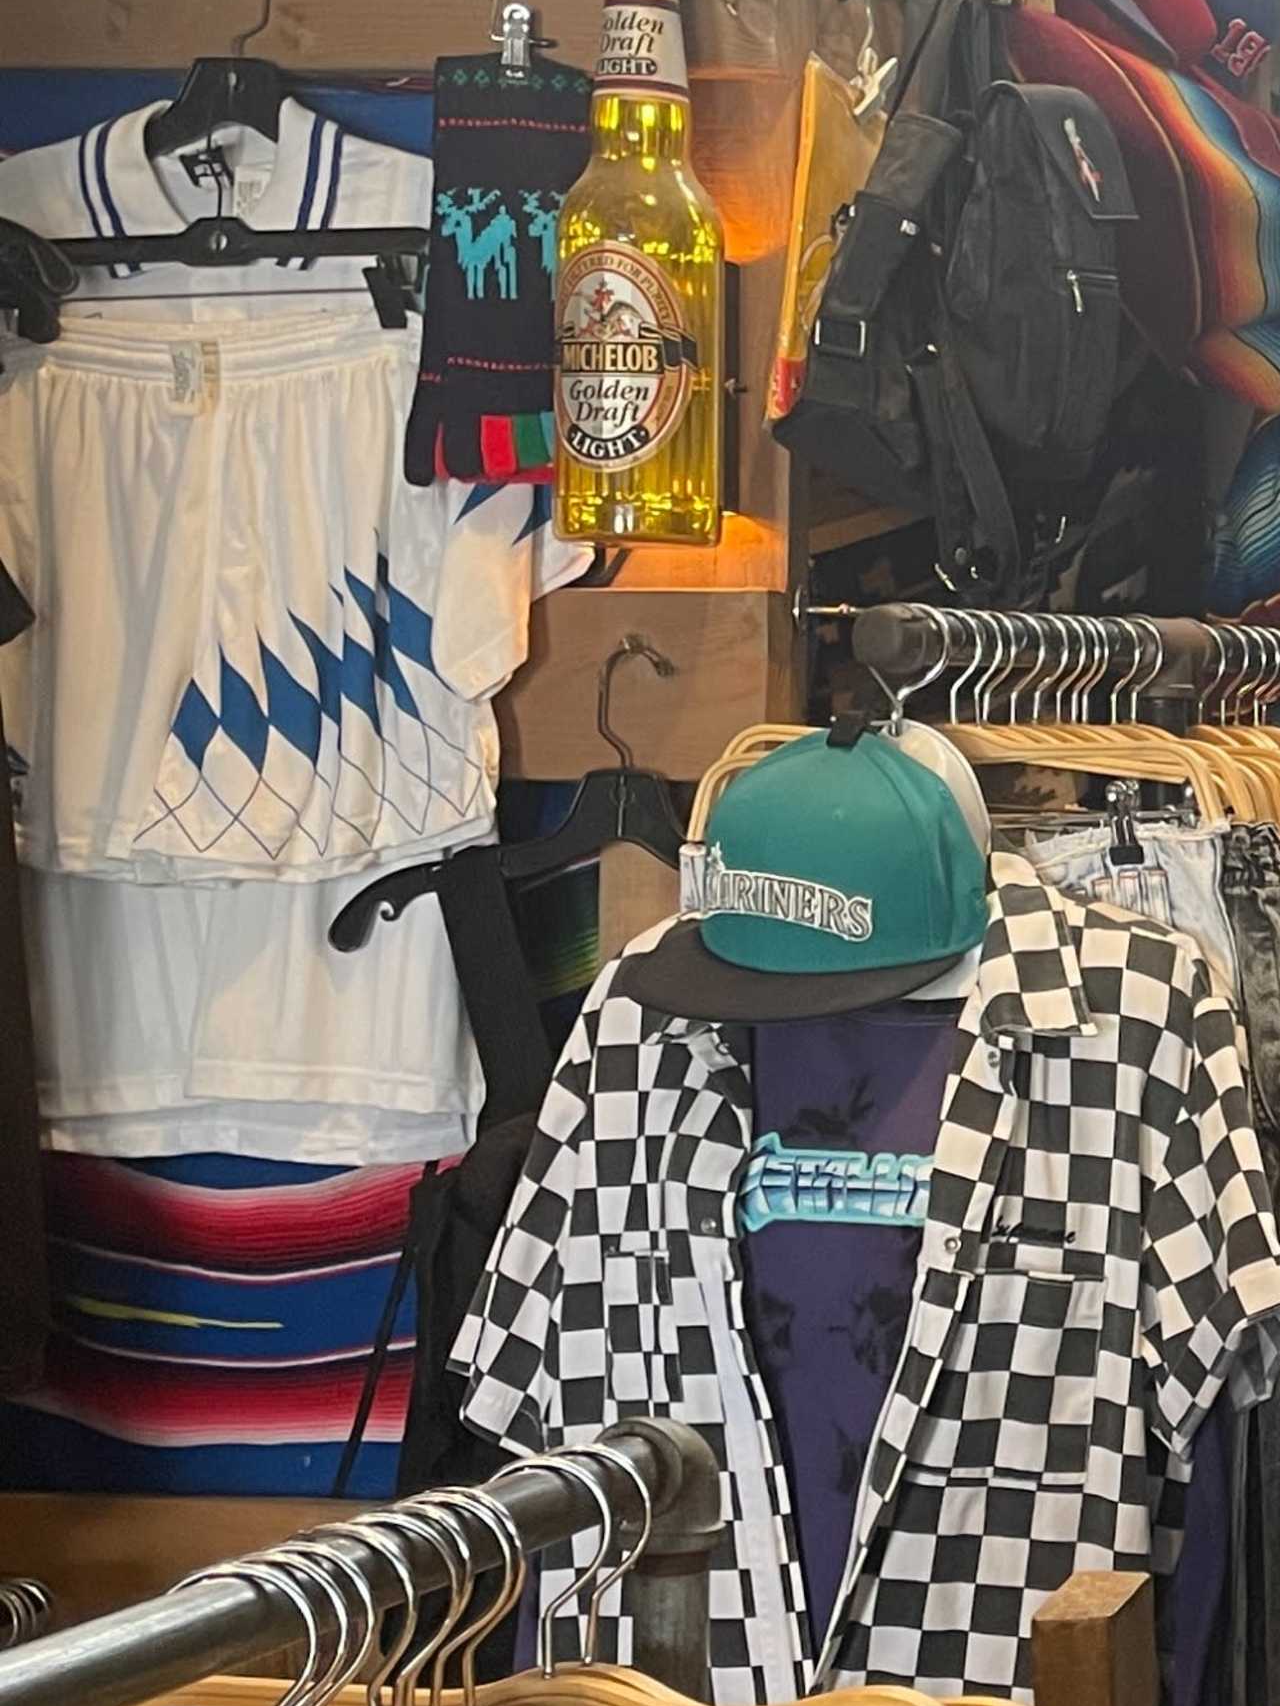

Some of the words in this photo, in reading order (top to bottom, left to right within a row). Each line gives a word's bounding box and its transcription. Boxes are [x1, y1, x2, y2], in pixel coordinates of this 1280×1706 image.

[602, 10, 664, 35] olden
[600, 58, 651, 74] IGHT
[617, 257, 642, 279] FOR
[640, 274, 671, 323] PURITY
[562, 343, 659, 373] MICHELOB
[569, 379, 650, 401] Golden
[575, 401, 640, 429] Draft
[570, 428, 641, 459] LIGHT
